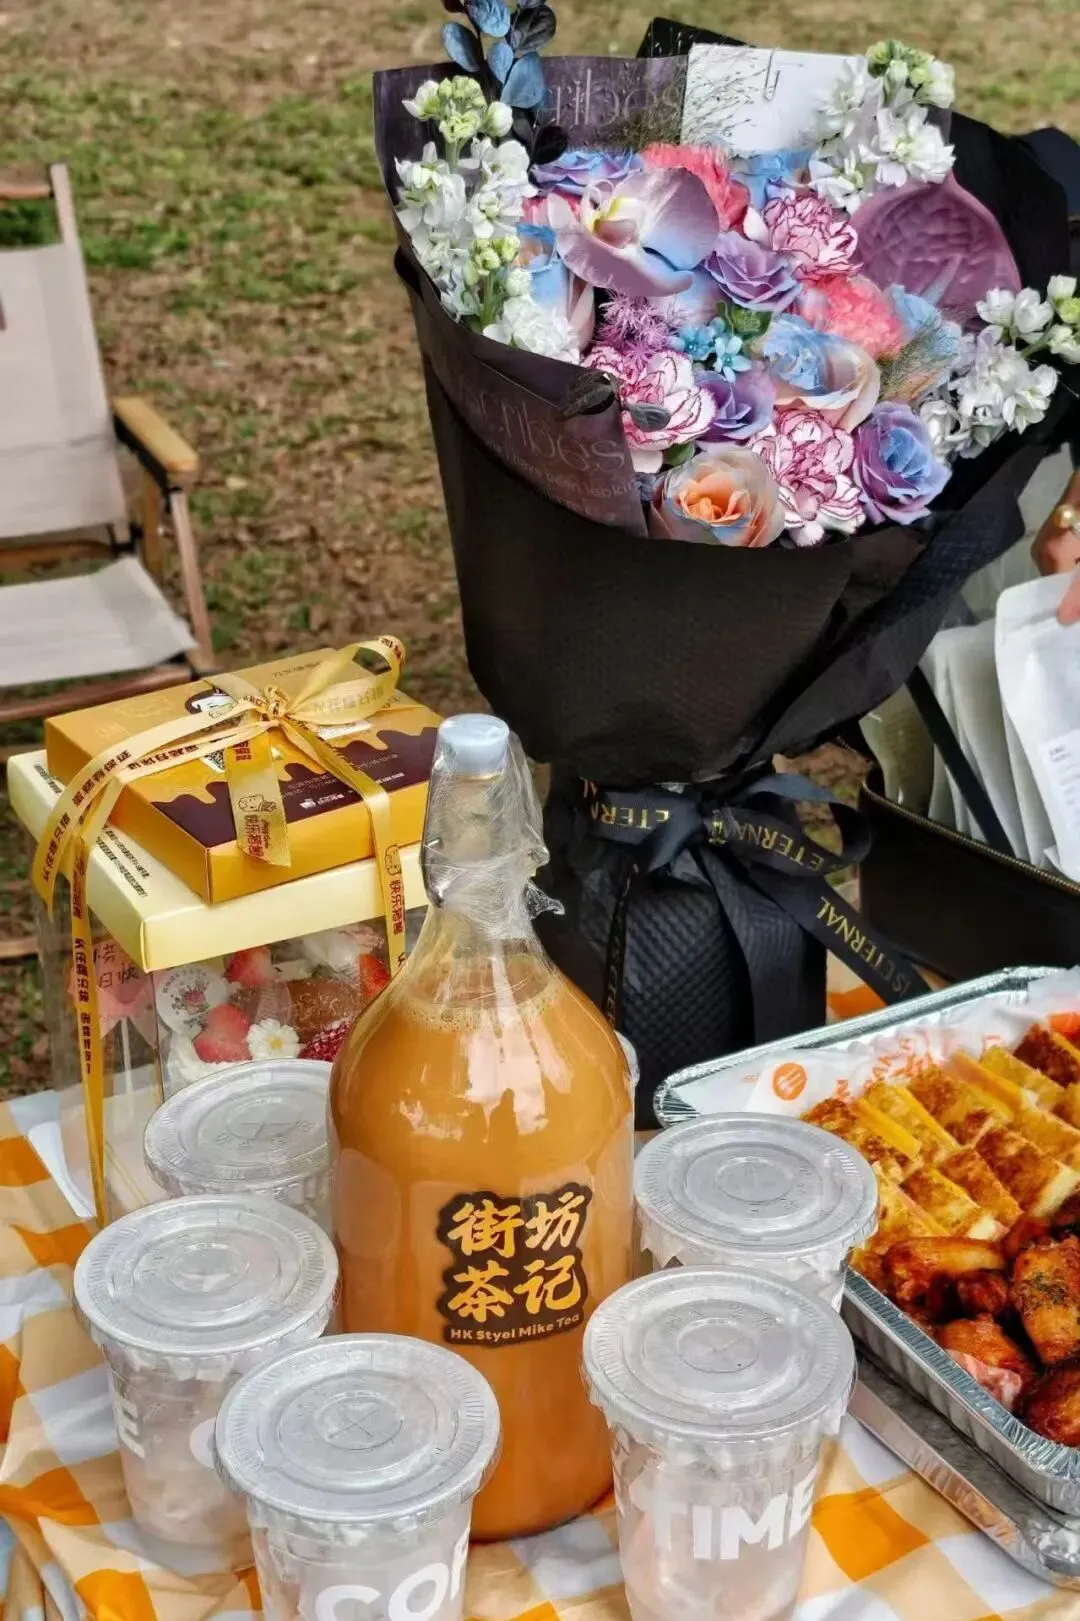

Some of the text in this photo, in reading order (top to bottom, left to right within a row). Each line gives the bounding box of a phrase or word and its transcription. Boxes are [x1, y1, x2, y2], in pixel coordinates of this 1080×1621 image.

[448, 1192, 585, 1258] 街坊
[448, 1255, 581, 1322] 茶记
[451, 1314, 580, 1342] HK Styel Mike Tea
